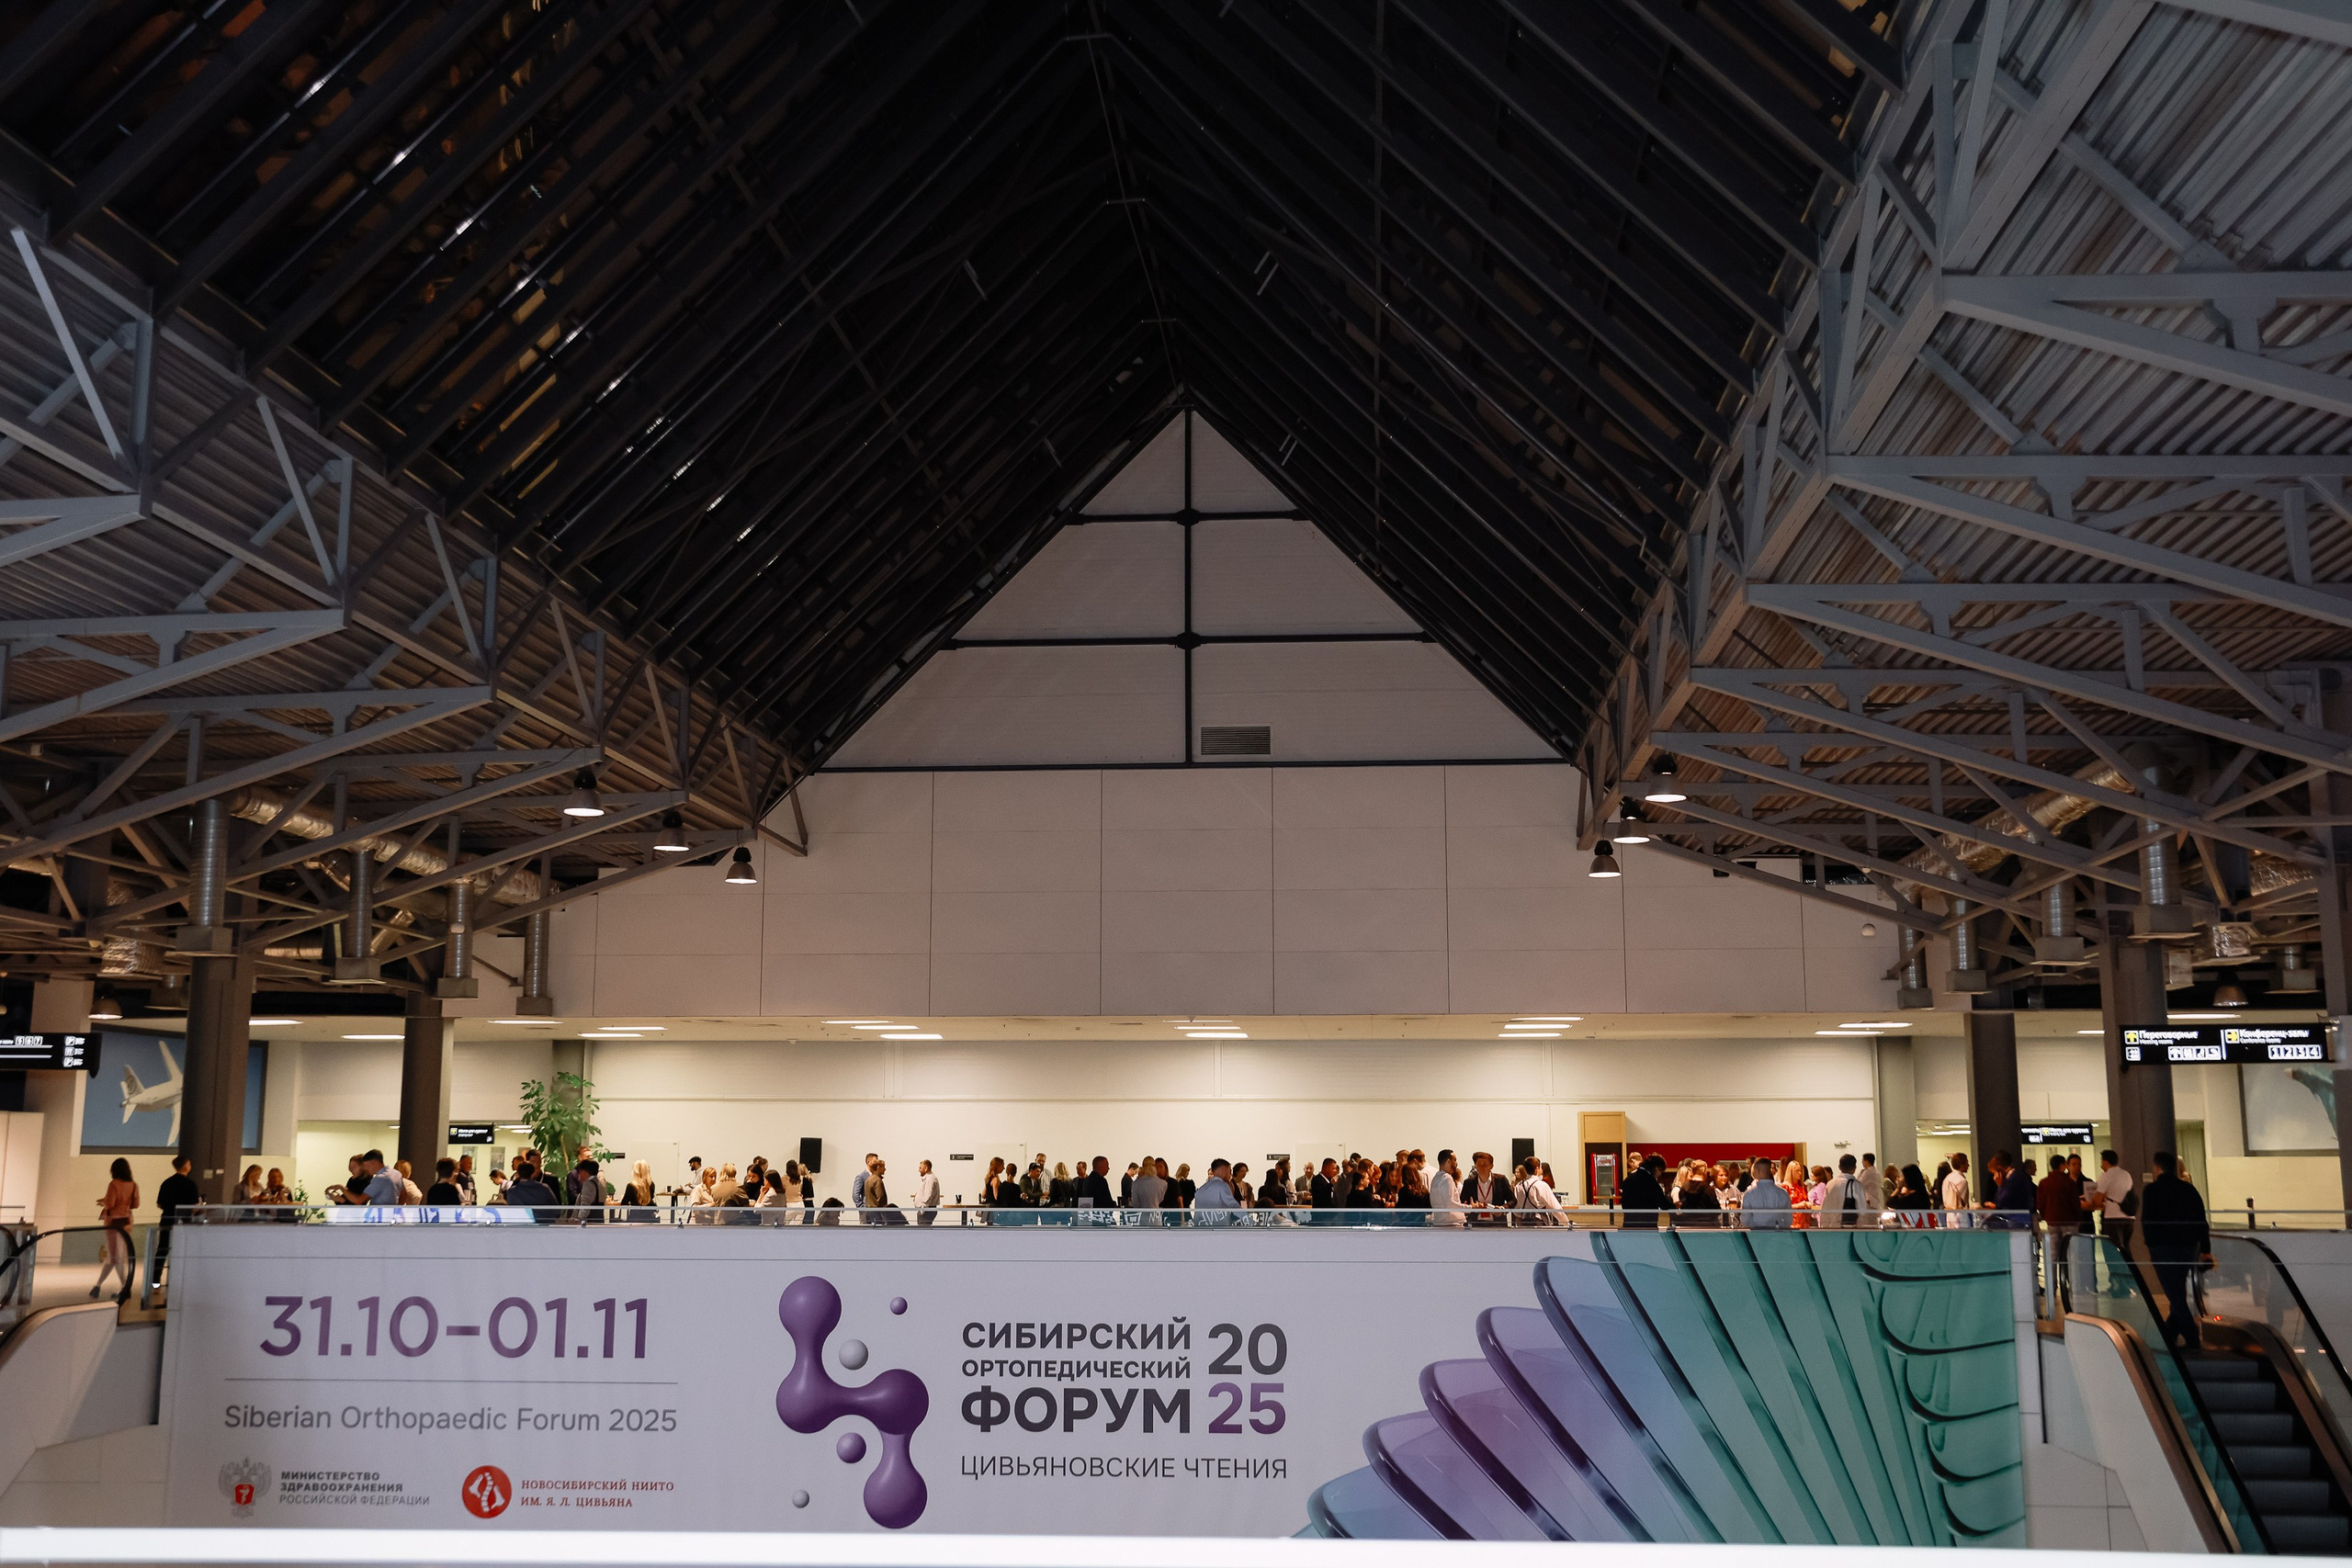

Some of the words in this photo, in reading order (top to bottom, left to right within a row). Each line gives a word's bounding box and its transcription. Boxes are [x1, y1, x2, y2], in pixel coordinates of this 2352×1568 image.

[962, 1316, 1191, 1349] СИБИРСКИЙ
[1208, 1323, 1287, 1375] 20
[962, 1357, 1191, 1382] ОРТОПЕДИЧЕСКИЙ
[224, 1404, 332, 1429] Siberian
[341, 1405, 507, 1435] Orthopaedic
[517, 1407, 600, 1431] Forum
[608, 1409, 677, 1432] 2025
[961, 1385, 1191, 1433] ФОРУМ
[1208, 1382, 1286, 1435] 25
[280, 1471, 380, 1481] МИНИСТЕРСТВО
[961, 1456, 1175, 1480] ЦИВЬЯНОВСКИЕ
[1184, 1458, 1287, 1479] ЧТЕНИЯ
[279, 1482, 403, 1493] ЗДРАВООХРАНЕНИЯ
[521, 1479, 628, 1490] НОВОСИБИРСКИЙ
[631, 1481, 674, 1491] НИИТО
[279, 1493, 357, 1505] РОССИЙСКОЙ
[360, 1495, 431, 1506] ФЕДЕРАЦИИ
[520, 1496, 542, 1506] ИМ.
[546, 1496, 556, 1506] Я.
[560, 1496, 571, 1506] Л.
[575, 1497, 633, 1508] ЦИВЬЯНА
